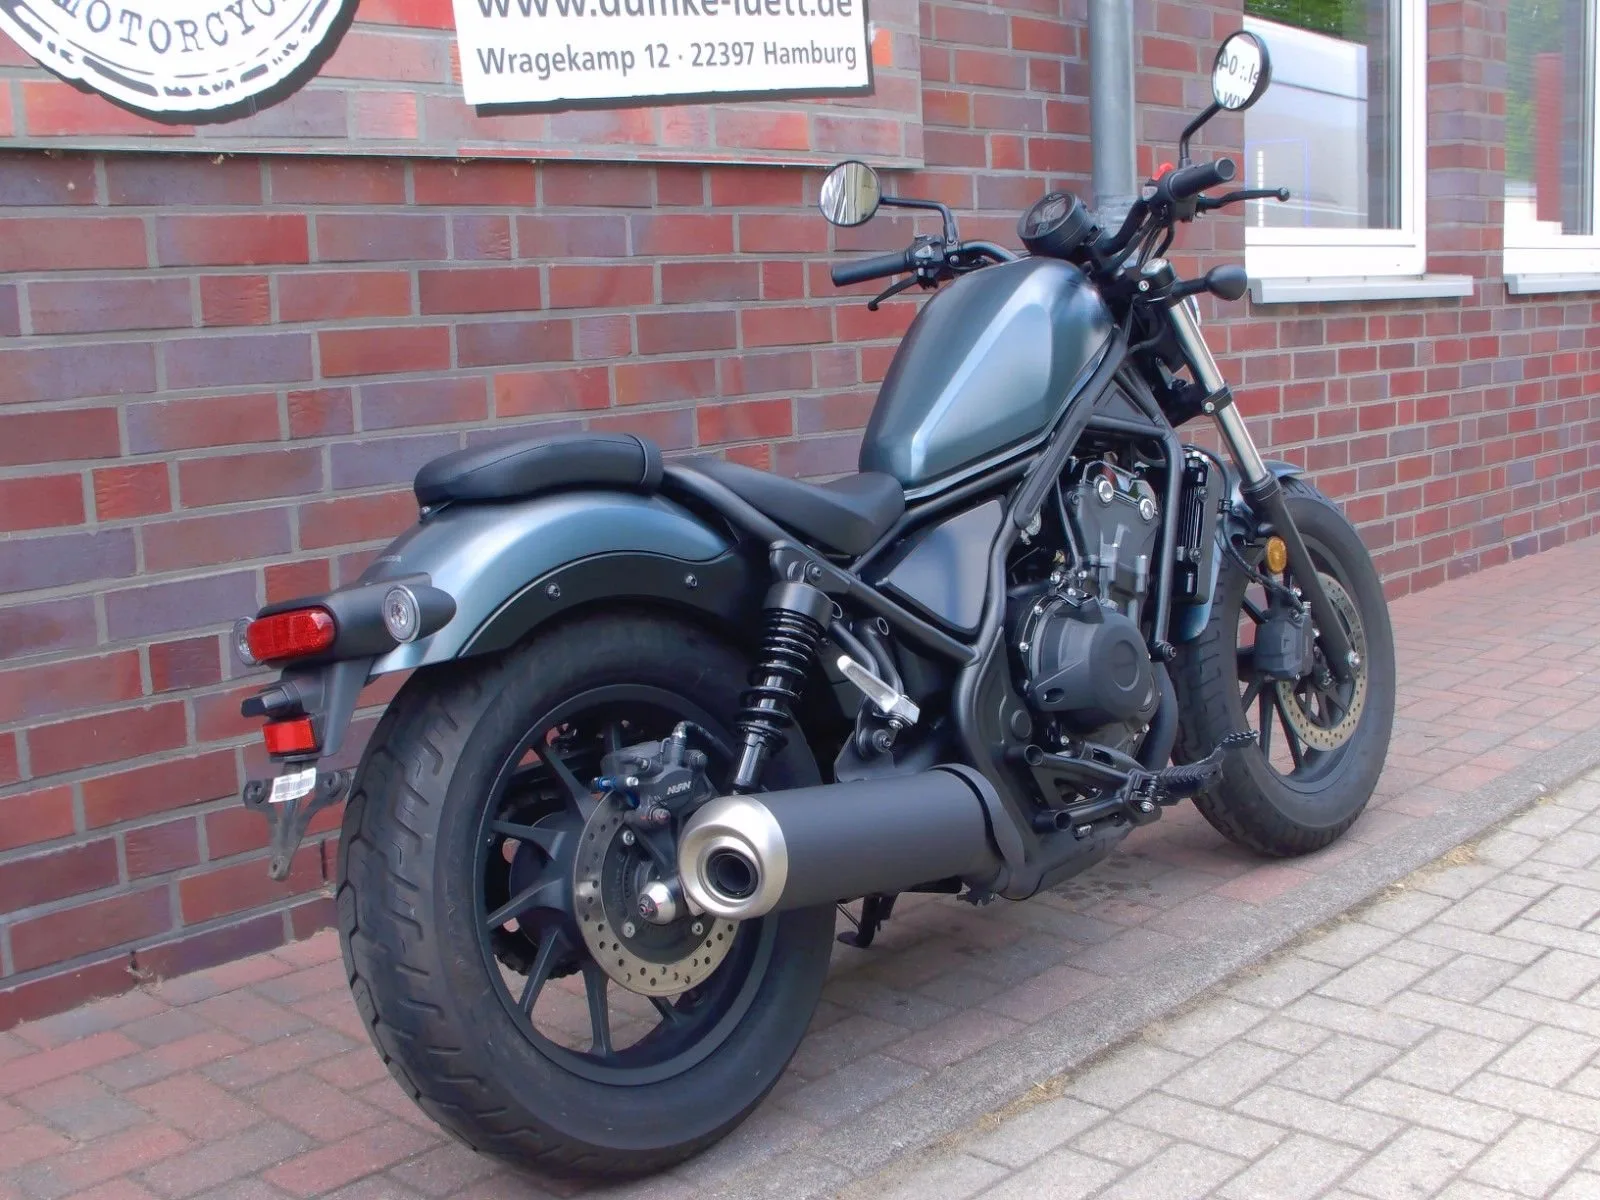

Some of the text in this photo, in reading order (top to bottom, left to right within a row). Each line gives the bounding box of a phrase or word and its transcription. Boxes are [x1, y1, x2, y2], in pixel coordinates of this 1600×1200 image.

[51, 0, 286, 54] OTORCY
[477, 43, 635, 81] Wragekamp
[644, 43, 670, 69] 12
[690, 41, 755, 67] 22397
[764, 39, 857, 71] Hamburg
